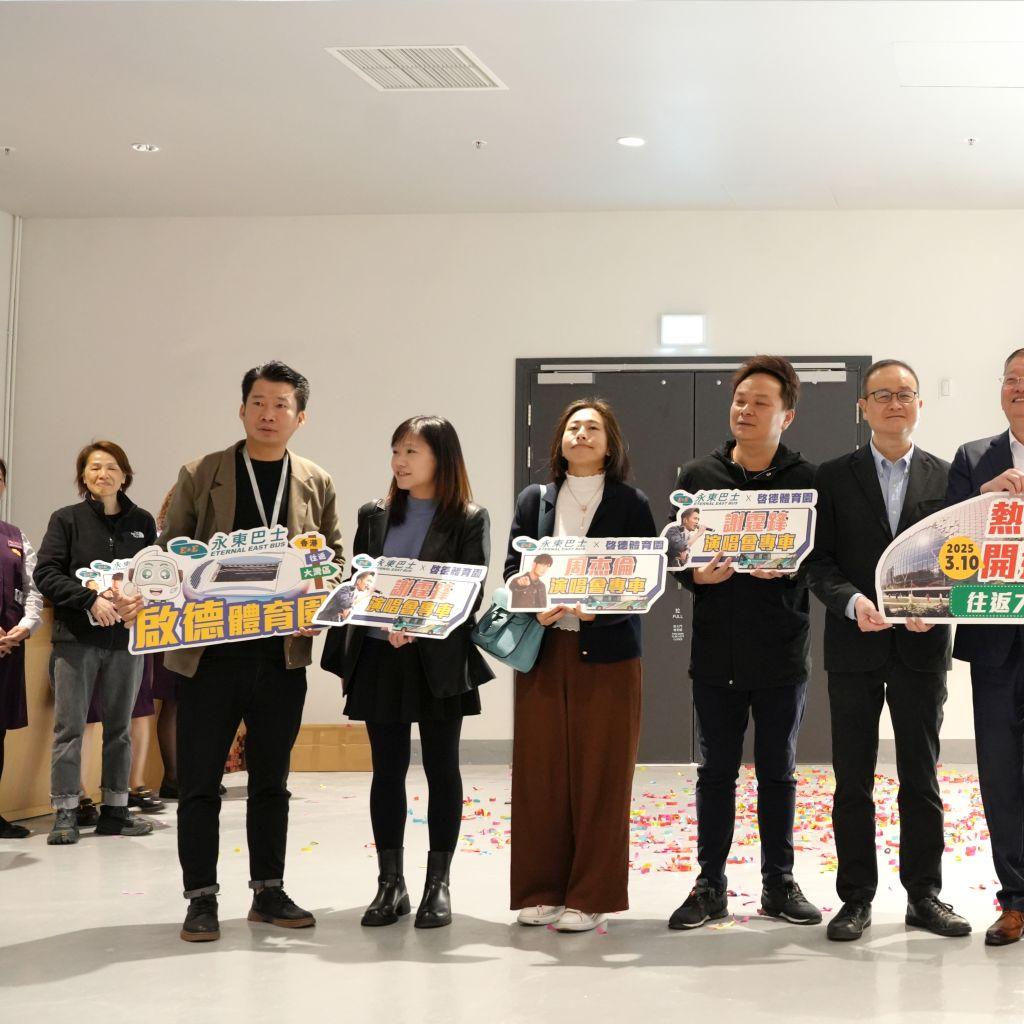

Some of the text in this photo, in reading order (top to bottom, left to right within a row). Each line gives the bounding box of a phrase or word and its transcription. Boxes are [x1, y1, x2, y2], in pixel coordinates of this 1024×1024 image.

[695, 493, 740, 501] 永東巴士
[211, 528, 288, 550] 永東巴士
[301, 539, 318, 547] 香港
[540, 539, 587, 548] 永東巴士
[703, 534, 796, 552] 演唱會專車
[210, 548, 246, 556] ETERNAL
[946, 544, 974, 554] 2025
[945, 556, 979, 570] 3.10
[549, 577, 646, 594] 演唱會專車
[367, 596, 454, 619] 演唱會專車
